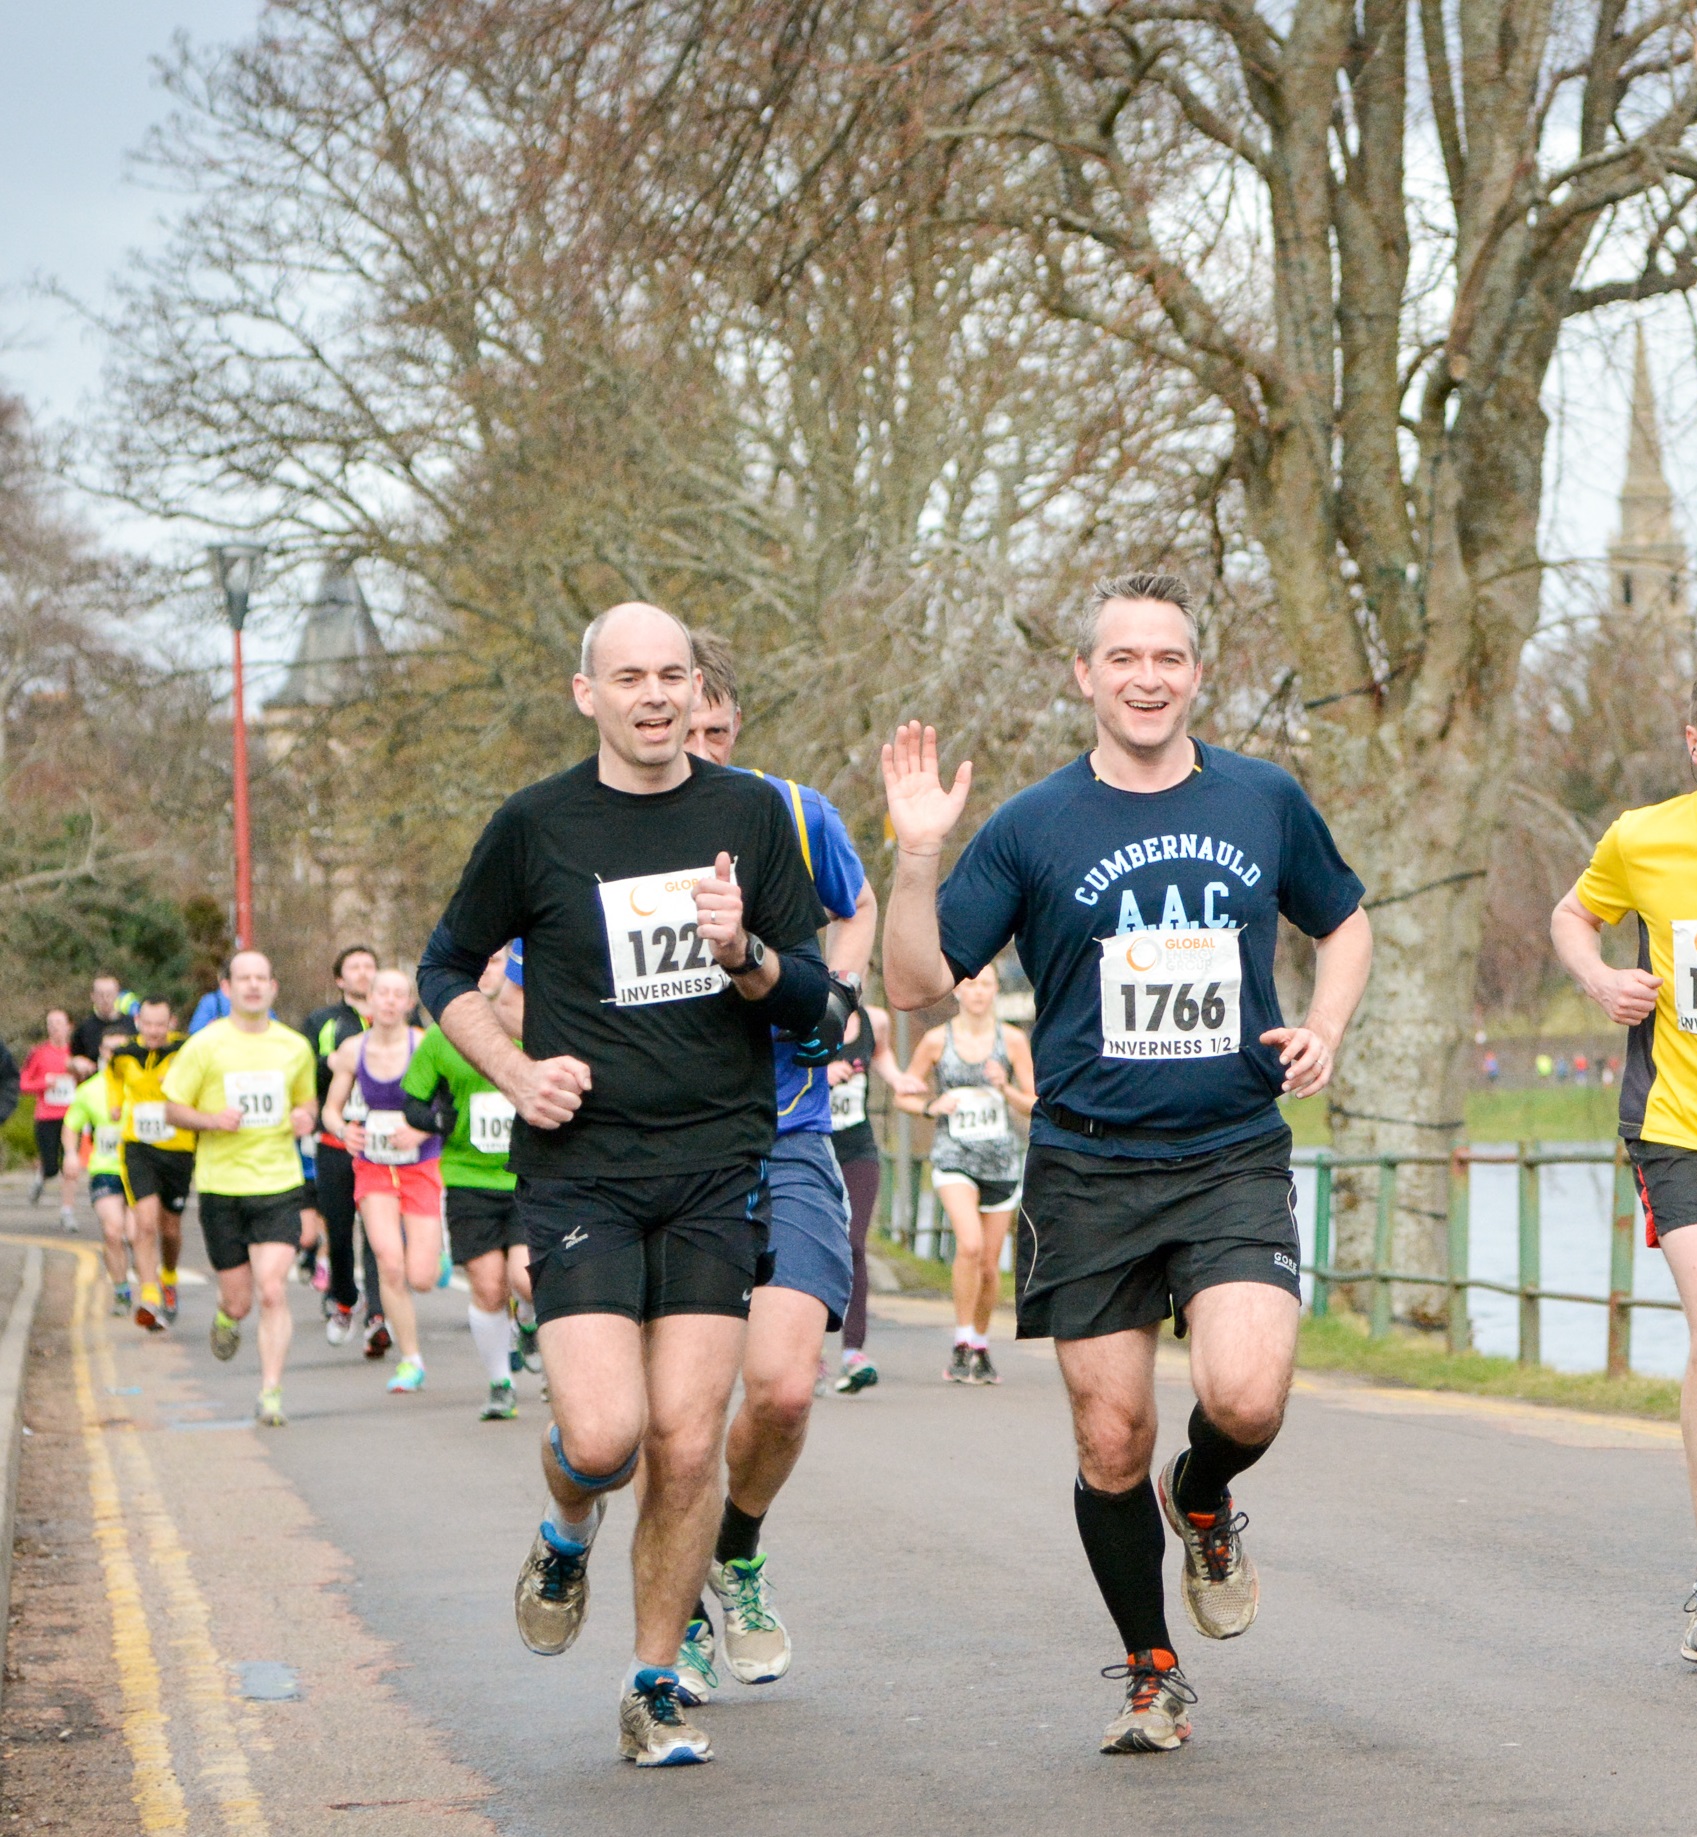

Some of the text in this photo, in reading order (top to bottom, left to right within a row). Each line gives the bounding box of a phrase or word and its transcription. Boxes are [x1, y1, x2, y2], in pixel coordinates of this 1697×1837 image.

[1074, 833, 1262, 907] CUMBERNAULD
[1115, 881, 1238, 935] A.A.C.
[627, 922, 714, 978] 122
[1164, 936, 1216, 950] GLOBAL
[621, 976, 713, 1004] INVERNESS
[1120, 981, 1226, 1033] 1766
[1210, 1036, 1232, 1054] 1/2
[238, 1092, 273, 1115] 510
[1273, 1251, 1298, 1272] GORE
